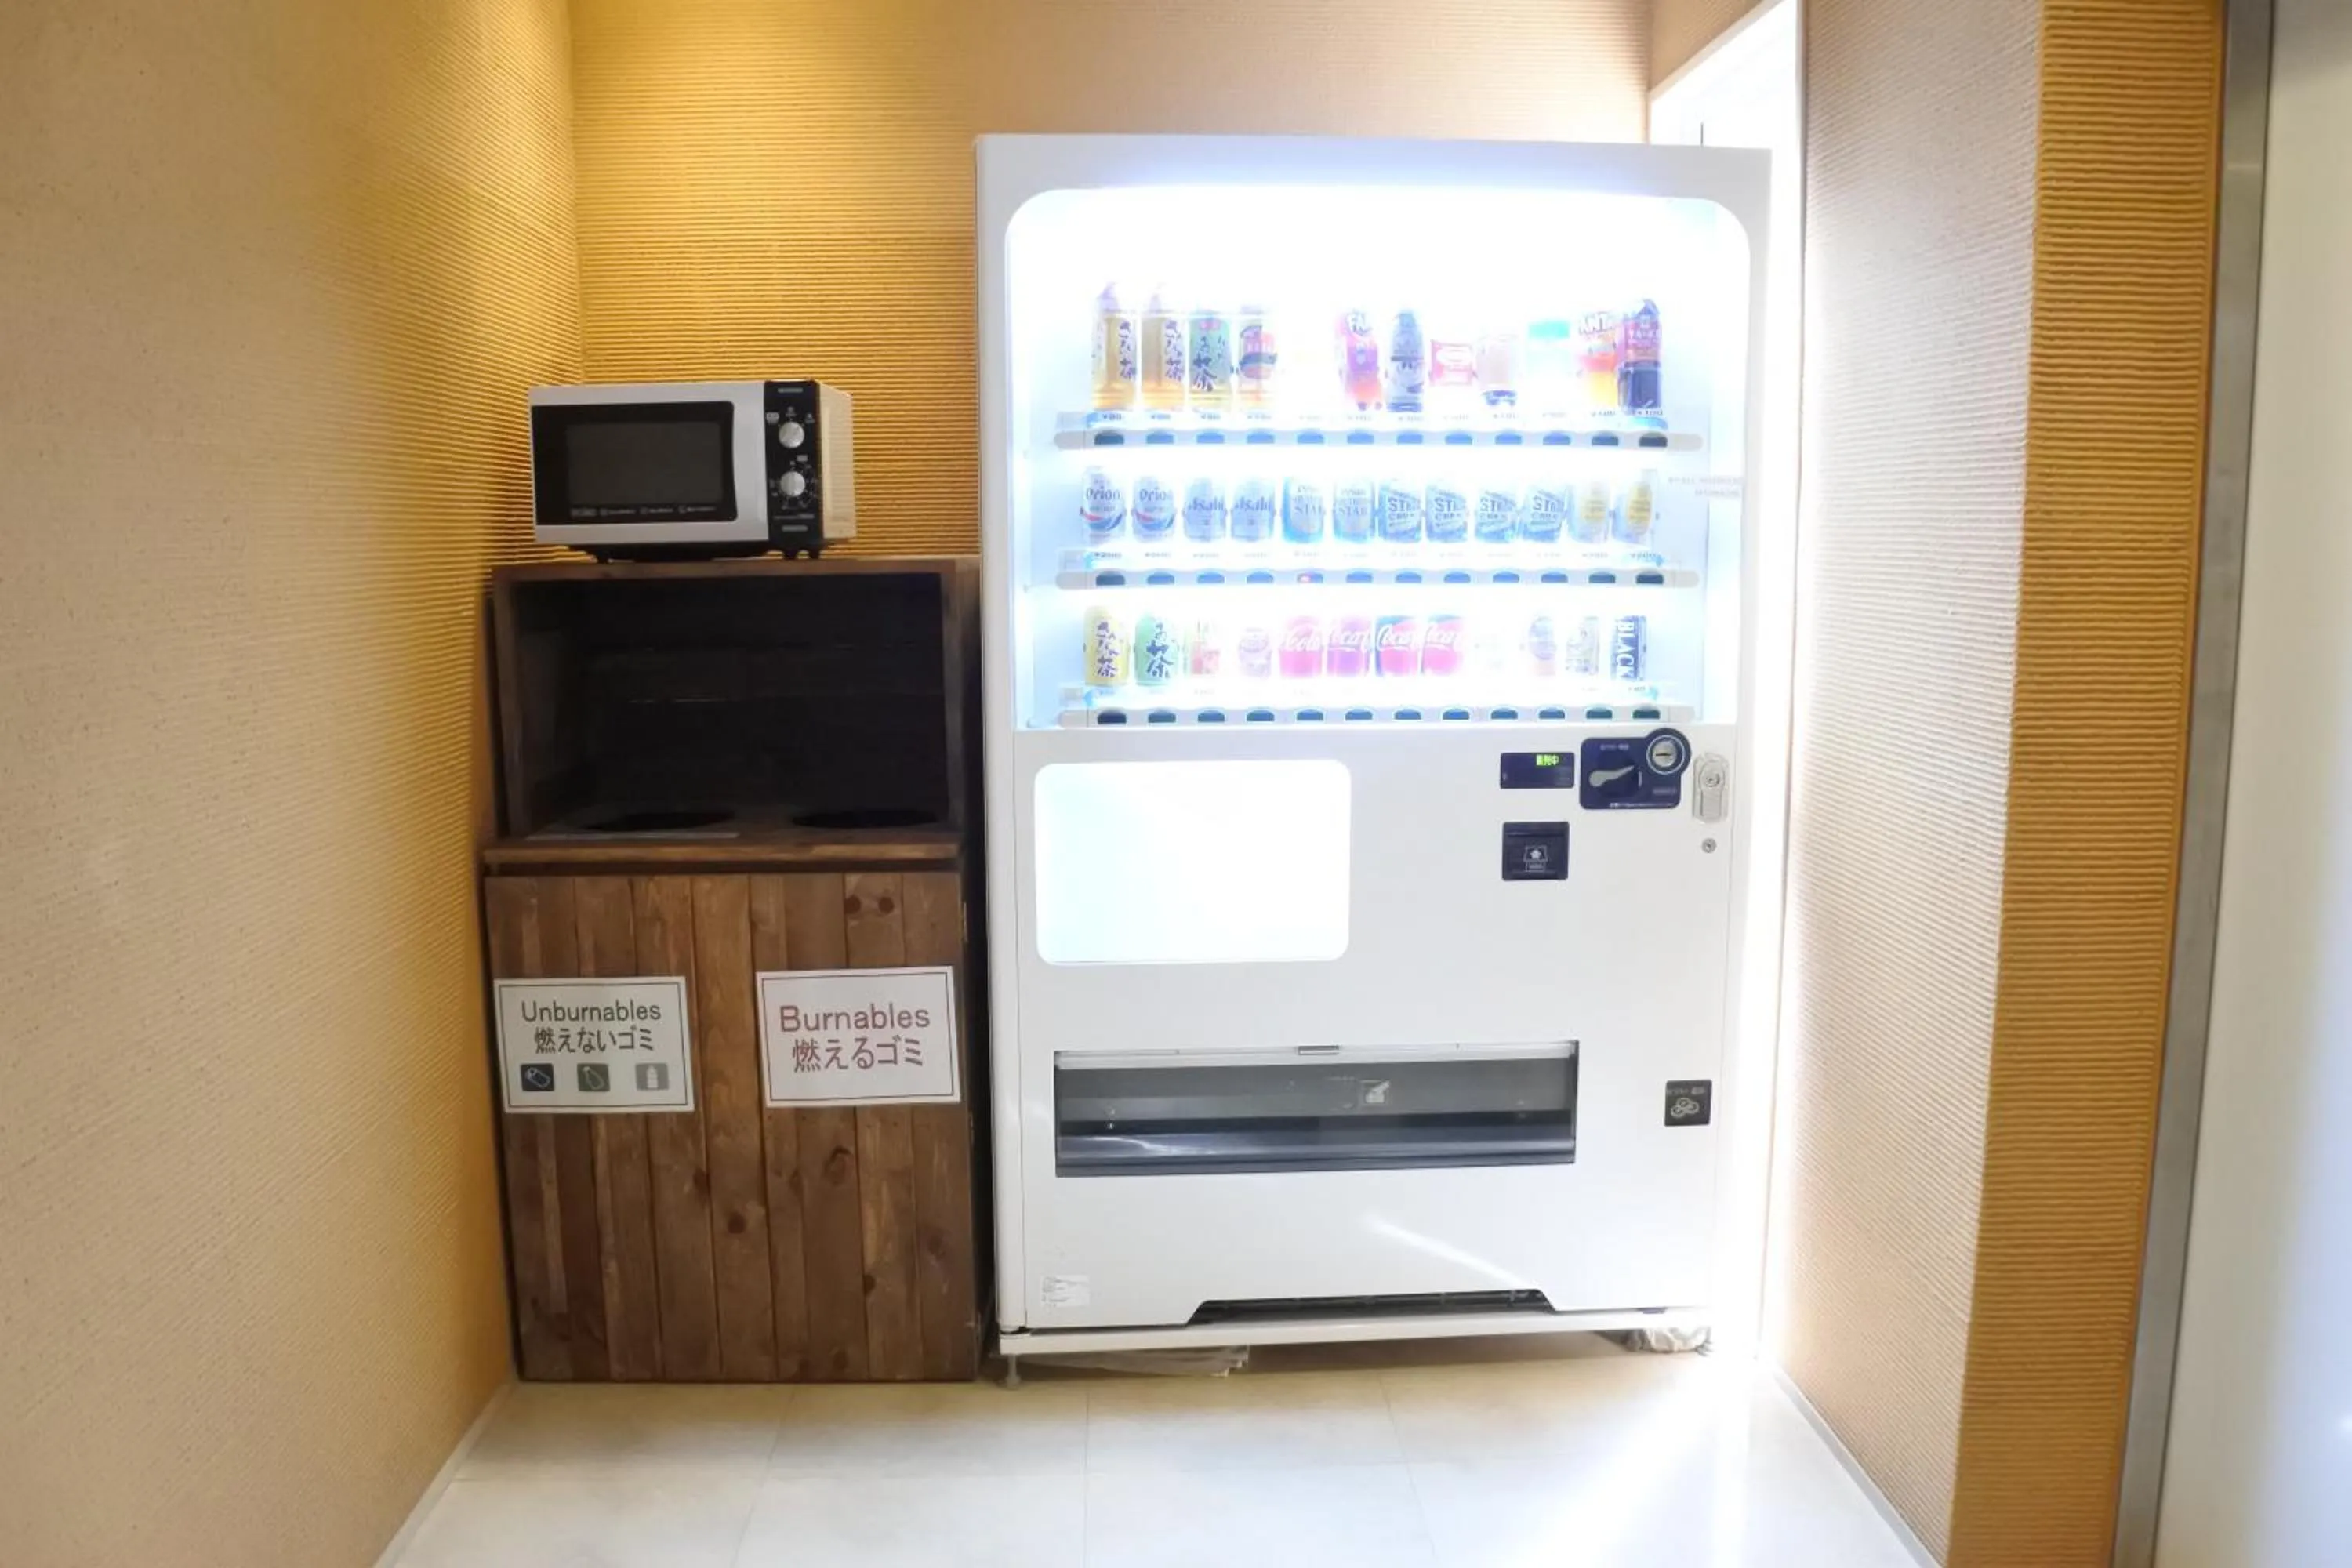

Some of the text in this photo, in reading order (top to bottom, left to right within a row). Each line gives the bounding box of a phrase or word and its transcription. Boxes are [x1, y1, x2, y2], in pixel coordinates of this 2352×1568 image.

[521, 1000, 661, 1022] Unburnables
[779, 1004, 931, 1033] Burnables
[535, 1027, 655, 1054] 燃えないゴミ
[793, 1037, 924, 1073] 燃えるゴミ
